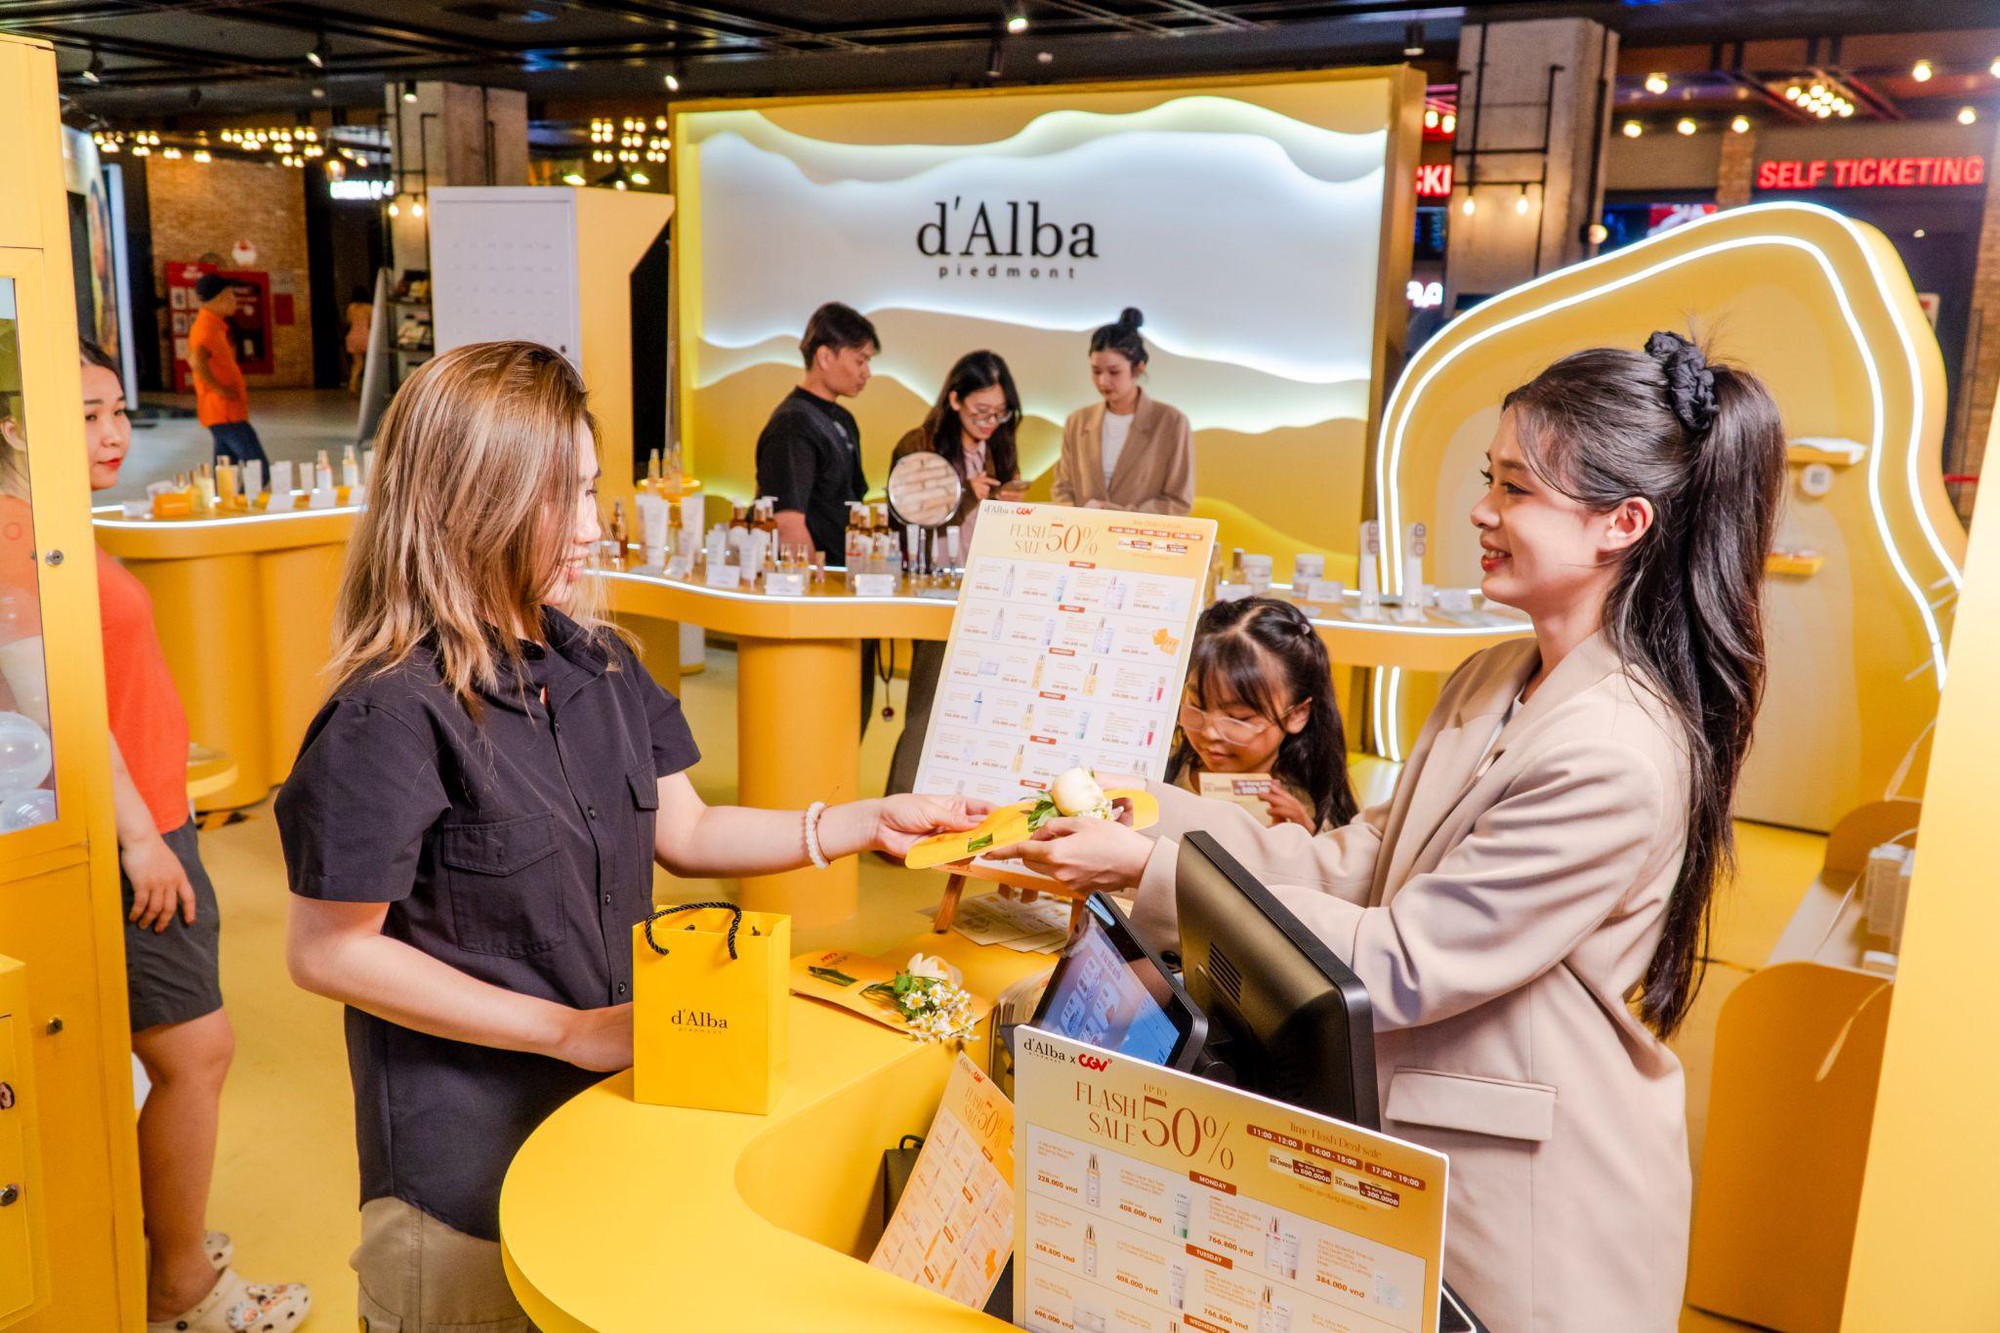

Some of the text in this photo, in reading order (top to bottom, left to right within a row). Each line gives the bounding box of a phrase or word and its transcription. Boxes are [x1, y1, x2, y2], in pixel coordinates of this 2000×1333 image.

[1756, 155, 1985, 190] SELF TICKETING
[916, 195, 1099, 258] d'Alba
[938, 264, 1076, 280] piedmont
[1046, 523, 1100, 556] 50%
[671, 1009, 728, 1029] d'Alba
[1023, 1038, 1066, 1062] d'Alba
[1078, 1053, 1109, 1072] CGV
[1076, 1080, 1137, 1120] FLASH
[1088, 1111, 1136, 1147] SALE
[1141, 1095, 1234, 1171] 50%
[1252, 1127, 1272, 1140] 11:00
[1278, 1135, 1297, 1148] 12:00
[1310, 1146, 1331, 1159] 14:00
[1336, 1154, 1357, 1167] 15:00
[1198, 1175, 1227, 1190] MONDAY
[1371, 1165, 1392, 1179] 17:00
[1399, 1174, 1420, 1187] 19:00
